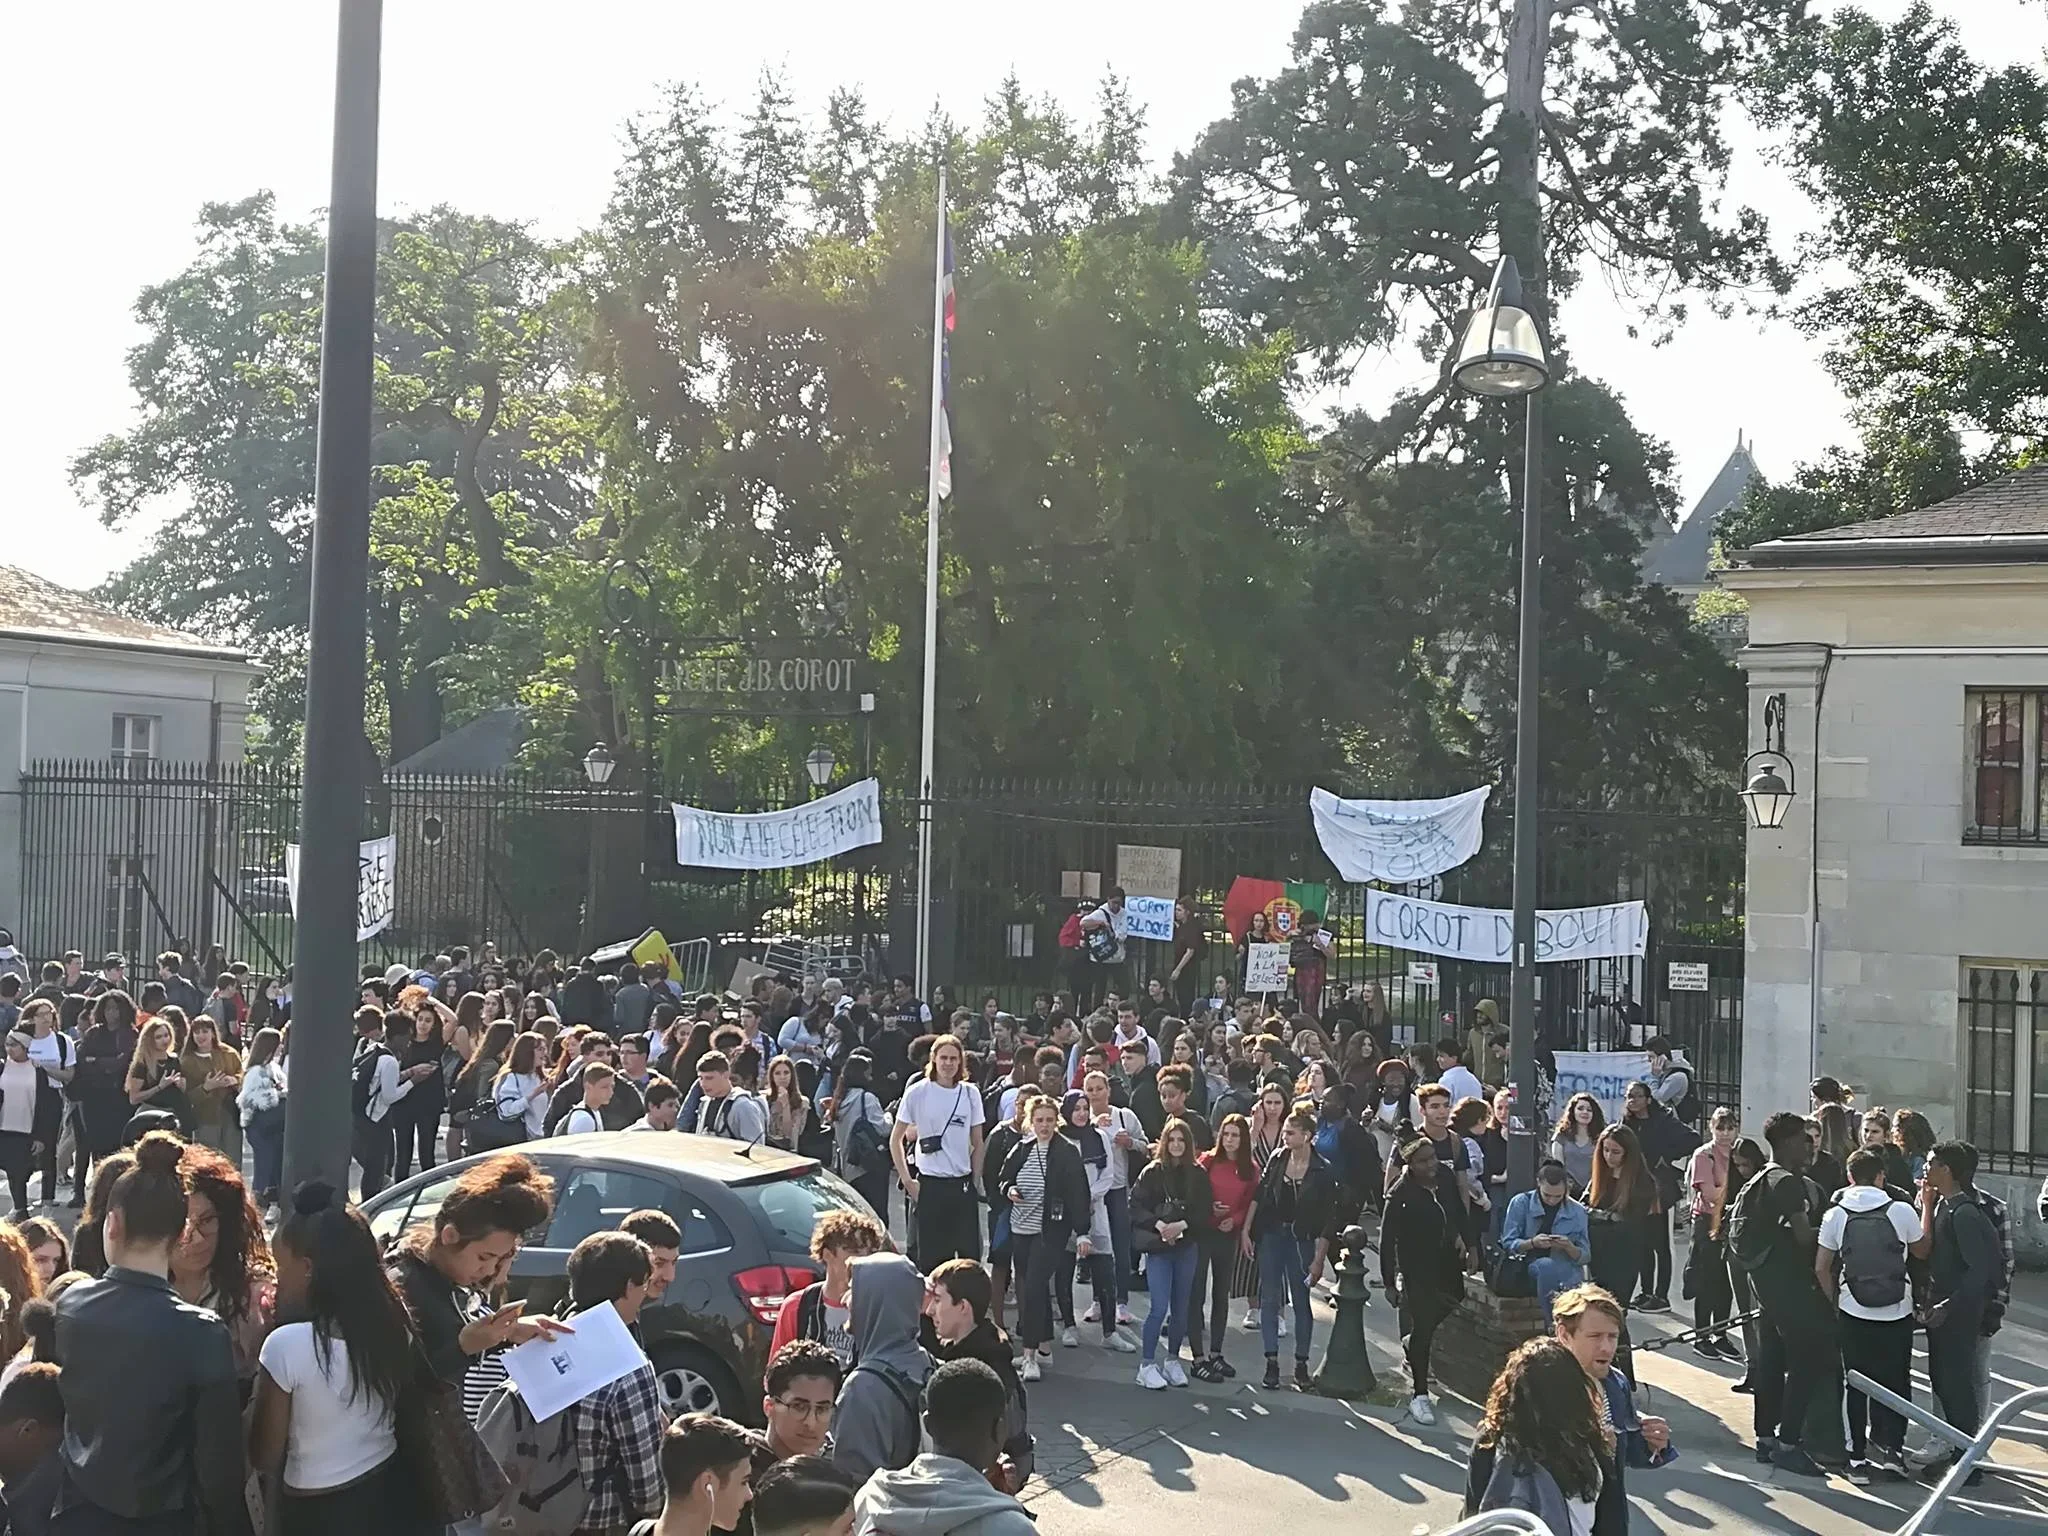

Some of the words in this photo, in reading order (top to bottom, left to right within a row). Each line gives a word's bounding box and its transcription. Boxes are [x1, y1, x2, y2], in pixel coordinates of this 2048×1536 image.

[779, 657, 857, 692] COROT
[695, 812, 736, 859] NON
[1375, 897, 1471, 952] COROT
[1494, 906, 1625, 957] DBOUT
[1256, 950, 1277, 959] NON
[1262, 960, 1275, 970] LA
